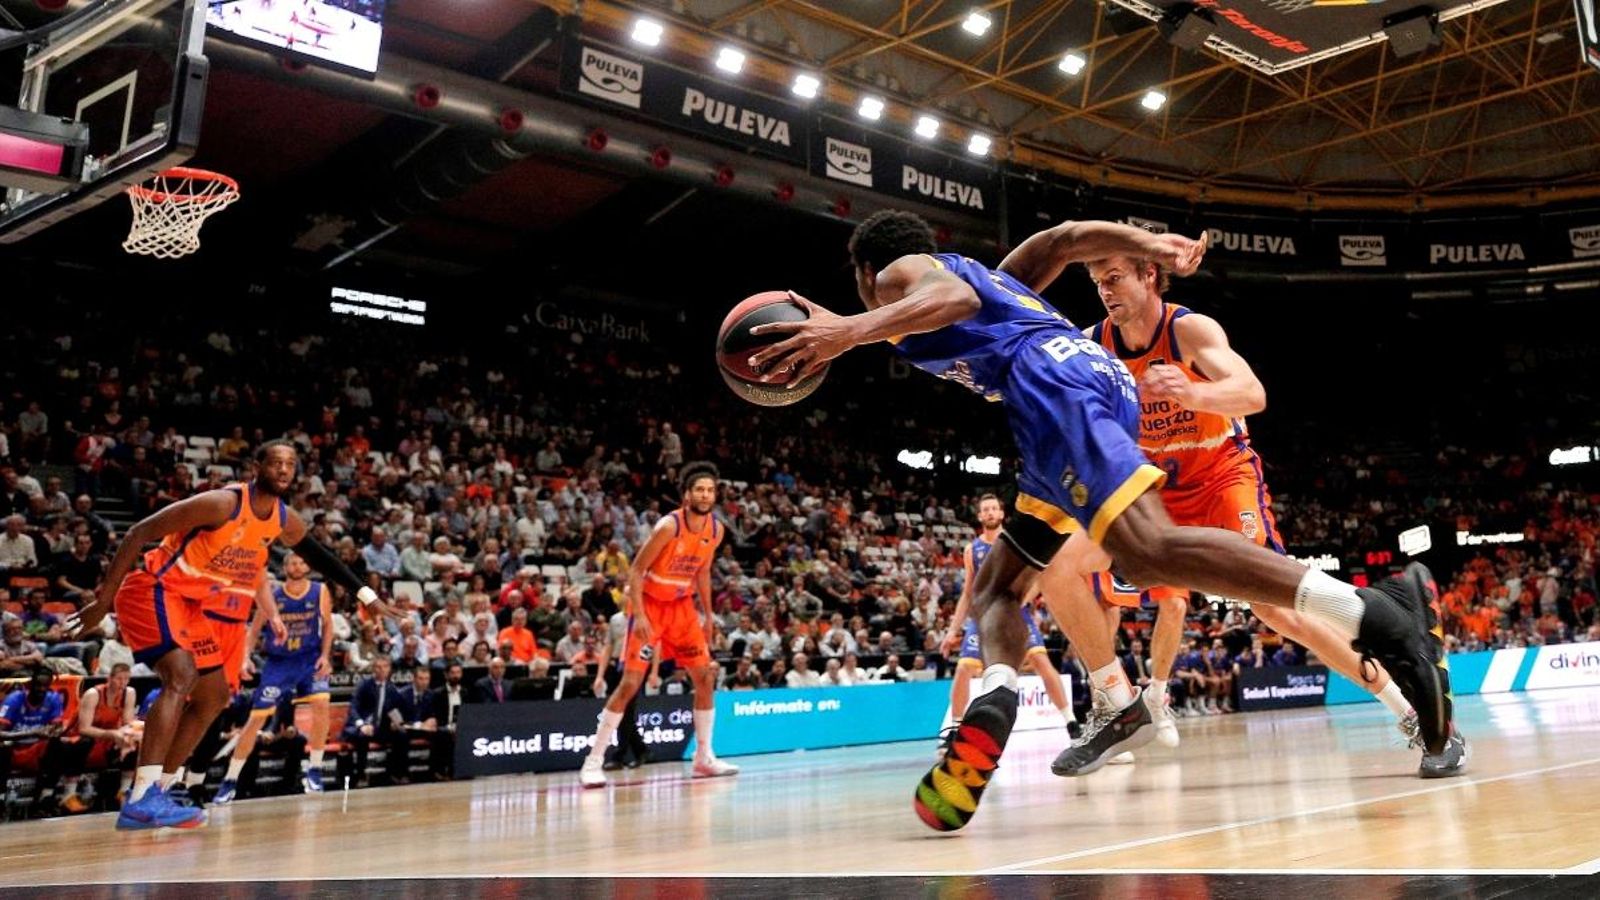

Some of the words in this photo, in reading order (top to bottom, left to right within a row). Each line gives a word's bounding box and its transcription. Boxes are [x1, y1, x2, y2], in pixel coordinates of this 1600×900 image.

[586, 54, 640, 82] PULEVA
[682, 87, 791, 147] PULEVA
[829, 142, 871, 164] PULEVA
[902, 164, 984, 211] PULEVA
[1207, 228, 1297, 255] PULEVA
[1342, 238, 1383, 249] PULEVA
[1429, 243, 1525, 264] PULEVA
[669, 709, 693, 725] de
[473, 734, 542, 757] Salud
